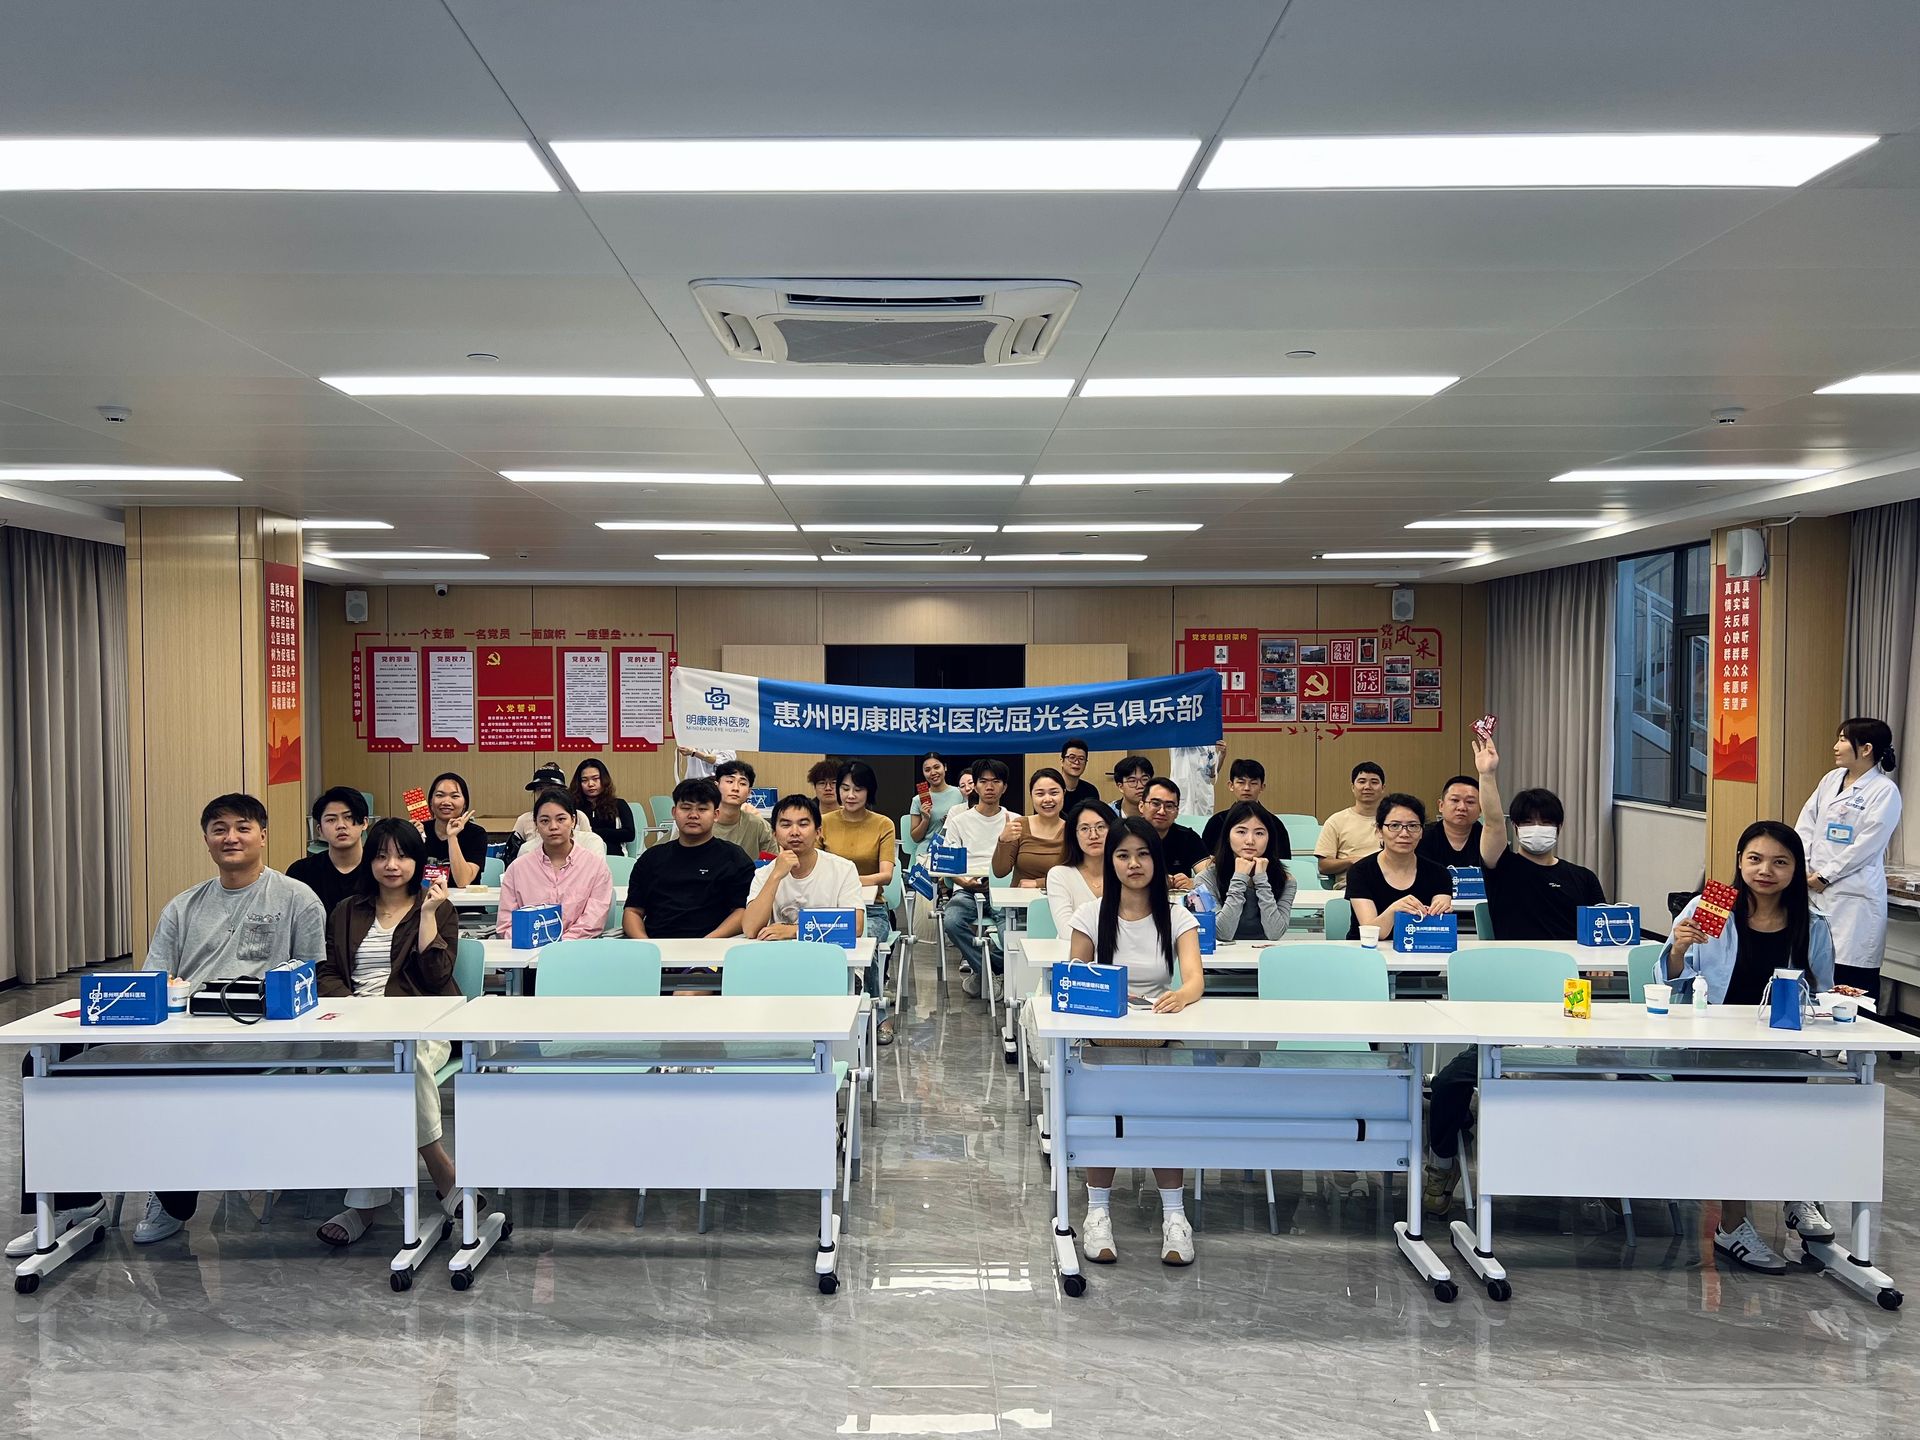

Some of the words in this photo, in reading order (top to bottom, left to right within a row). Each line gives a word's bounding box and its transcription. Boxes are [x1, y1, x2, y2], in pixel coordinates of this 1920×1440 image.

[408, 628, 455, 640] 一个支部
[464, 628, 511, 640] 一名党员
[520, 629, 566, 639] 一面旗帜
[575, 629, 621, 640] 一座堡垒
[1192, 633, 1248, 641] 党支部组织架构
[1380, 624, 1393, 650] 党员
[1395, 624, 1435, 660] 风采
[1723, 582, 1732, 710] 真情关心群众疾苦
[1731, 581, 1741, 710] 真实反映群众愿望
[1740, 580, 1749, 710] 真诚倾听群众呼声
[1356, 671, 1378, 682] 不忘
[1356, 682, 1378, 691] 初心
[495, 704, 536, 713] 入党誓词
[773, 694, 1203, 733] 惠州明康眼科医院屈光会员俱乐部
[686, 714, 750, 728] 明康眼科医院
